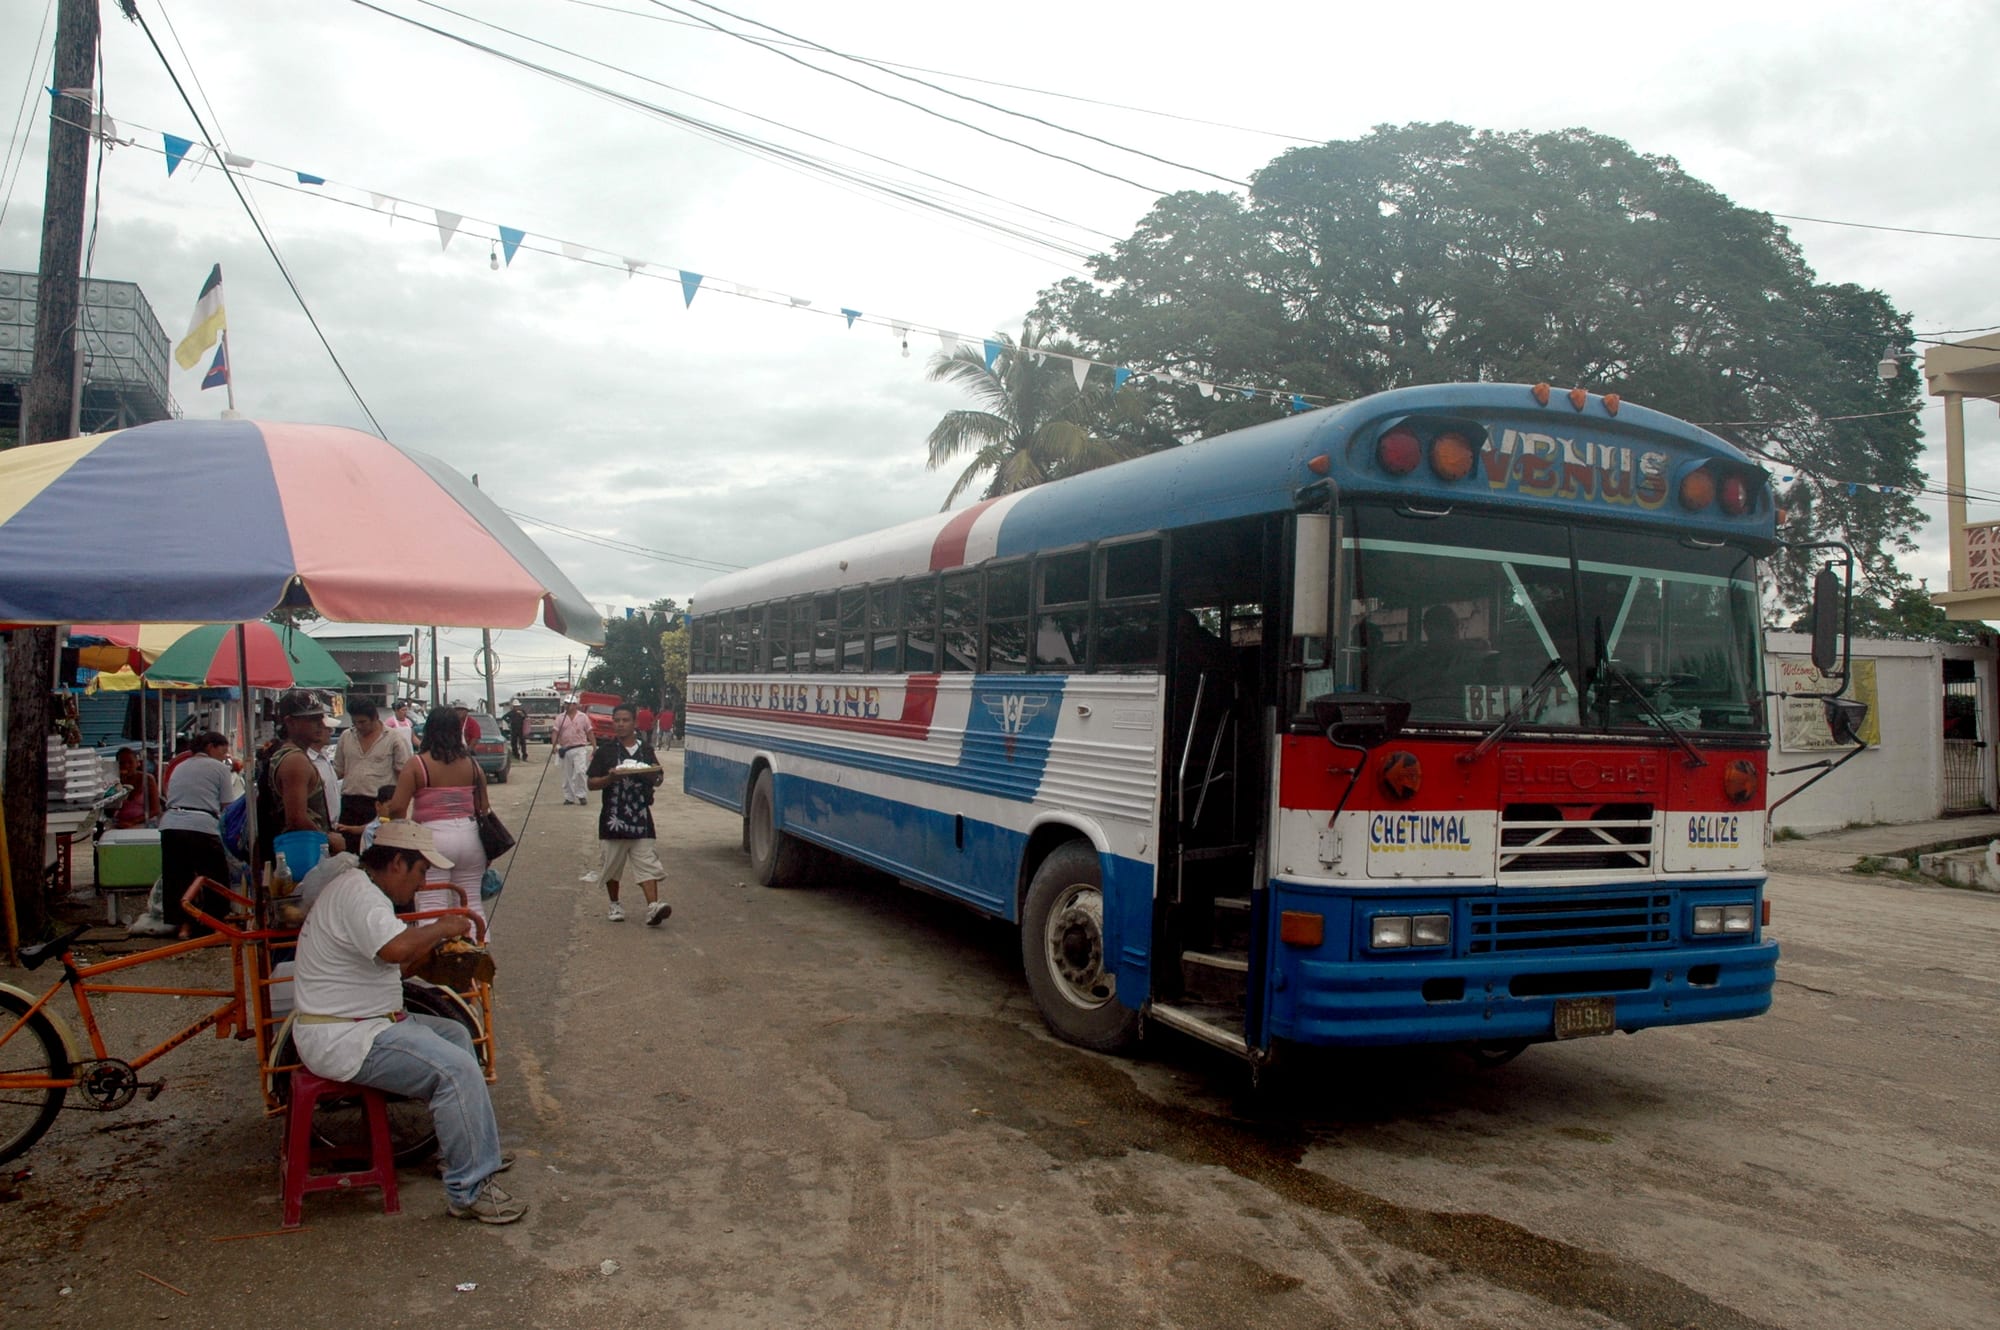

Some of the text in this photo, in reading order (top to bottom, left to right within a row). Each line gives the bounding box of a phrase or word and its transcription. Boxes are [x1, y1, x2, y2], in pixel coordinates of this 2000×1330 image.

[1481, 424, 1669, 510] VENUS
[768, 683, 808, 711] BUS
[815, 684, 880, 719] LINE
[1504, 765, 1566, 783] BLUE
[1370, 814, 1471, 847] CHETUMAL
[1688, 815, 1738, 845] BELIZE
